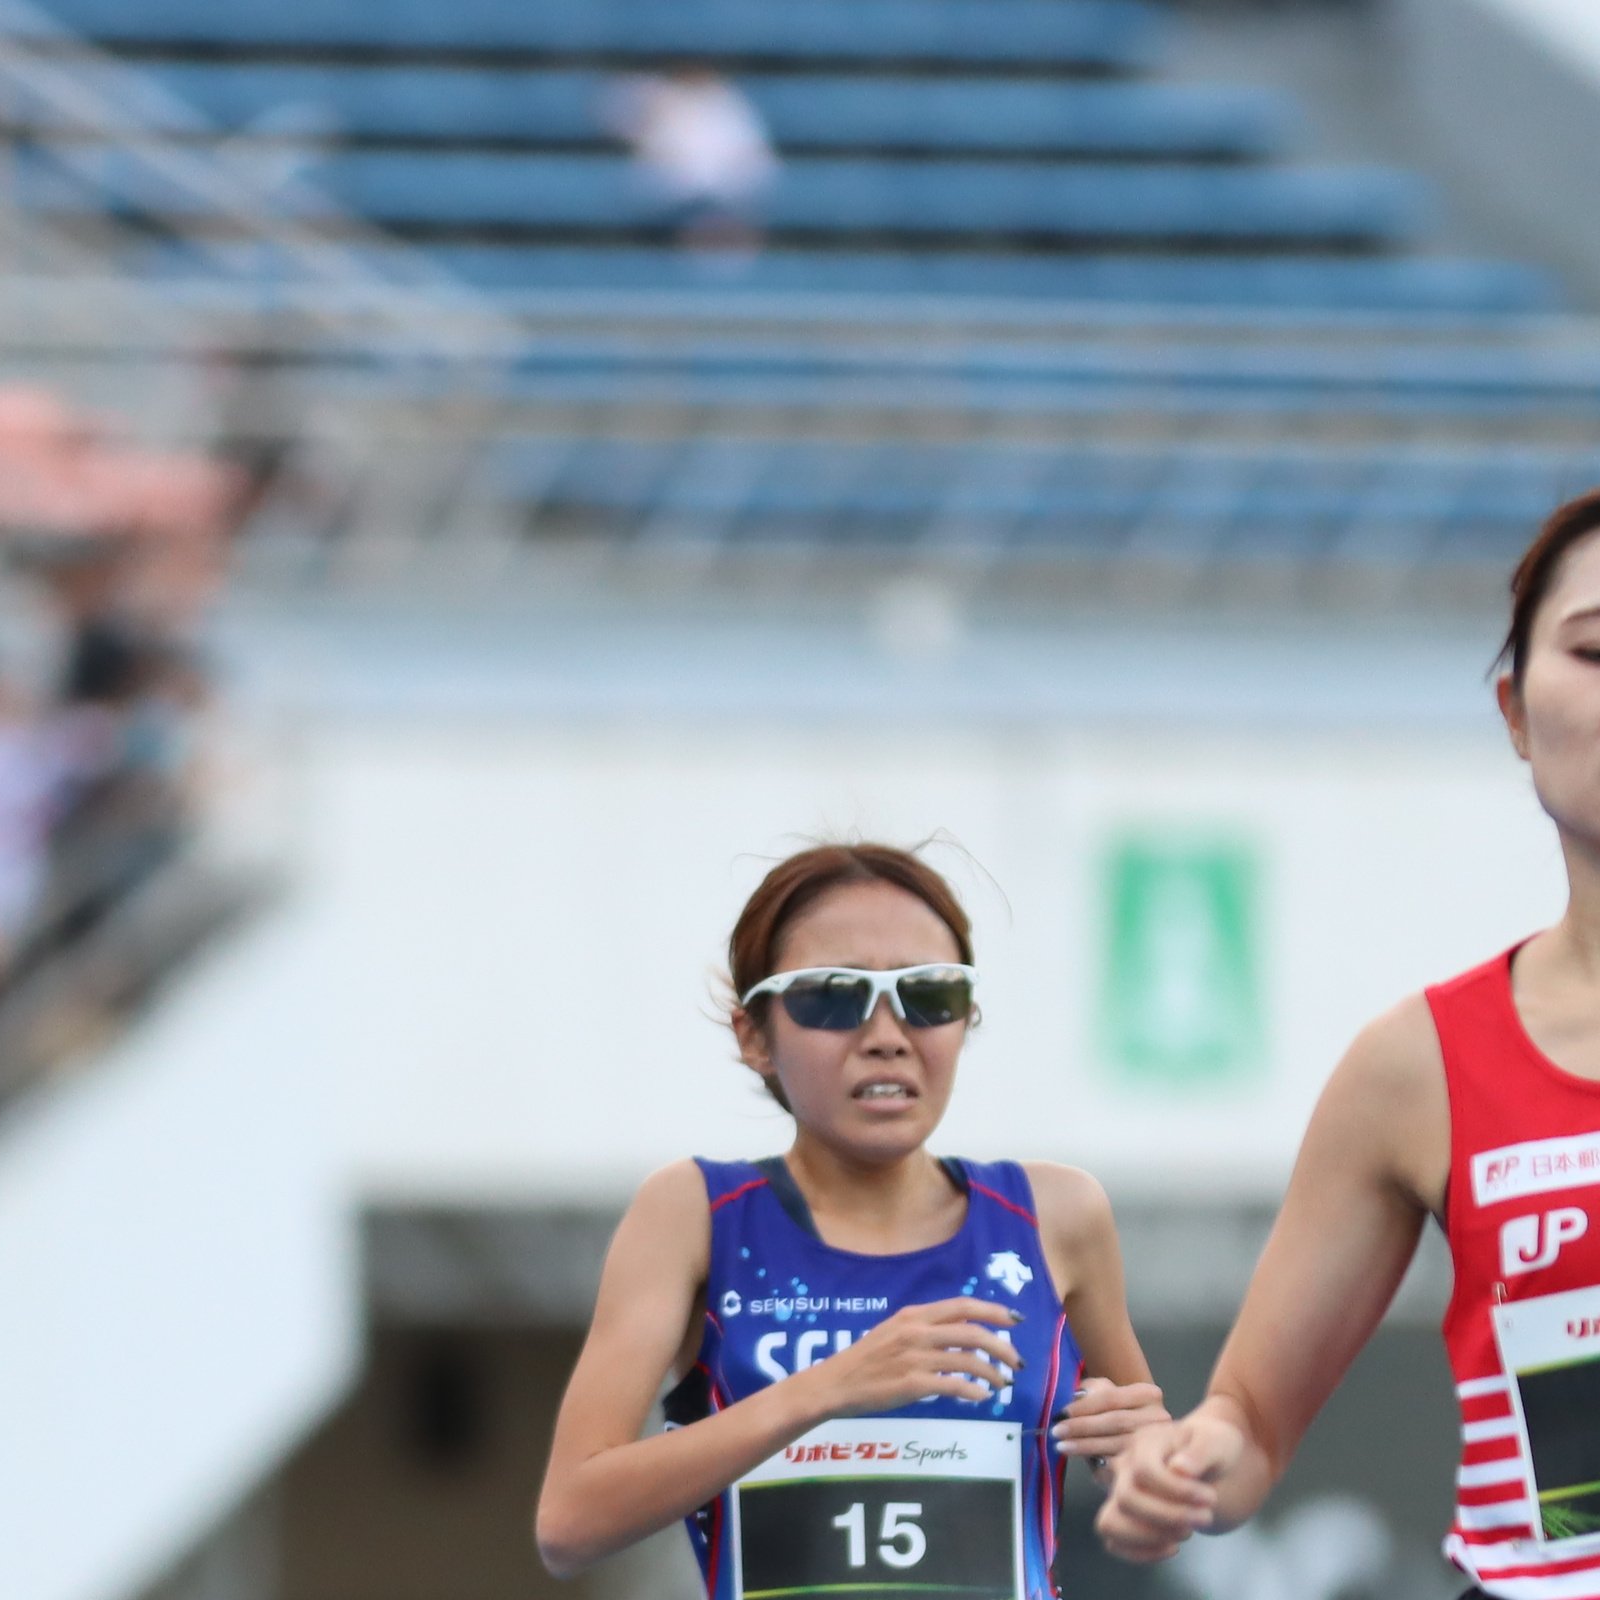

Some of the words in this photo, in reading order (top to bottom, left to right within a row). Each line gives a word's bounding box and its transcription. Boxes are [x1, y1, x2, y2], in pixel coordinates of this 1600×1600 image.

[1502, 1206, 1588, 1278] JP
[750, 1298, 829, 1313] SEKISUI
[836, 1296, 888, 1311] HEIM
[785, 1441, 900, 1464] リポビタン
[902, 1439, 969, 1467] Sports
[832, 1502, 927, 1568] 15
